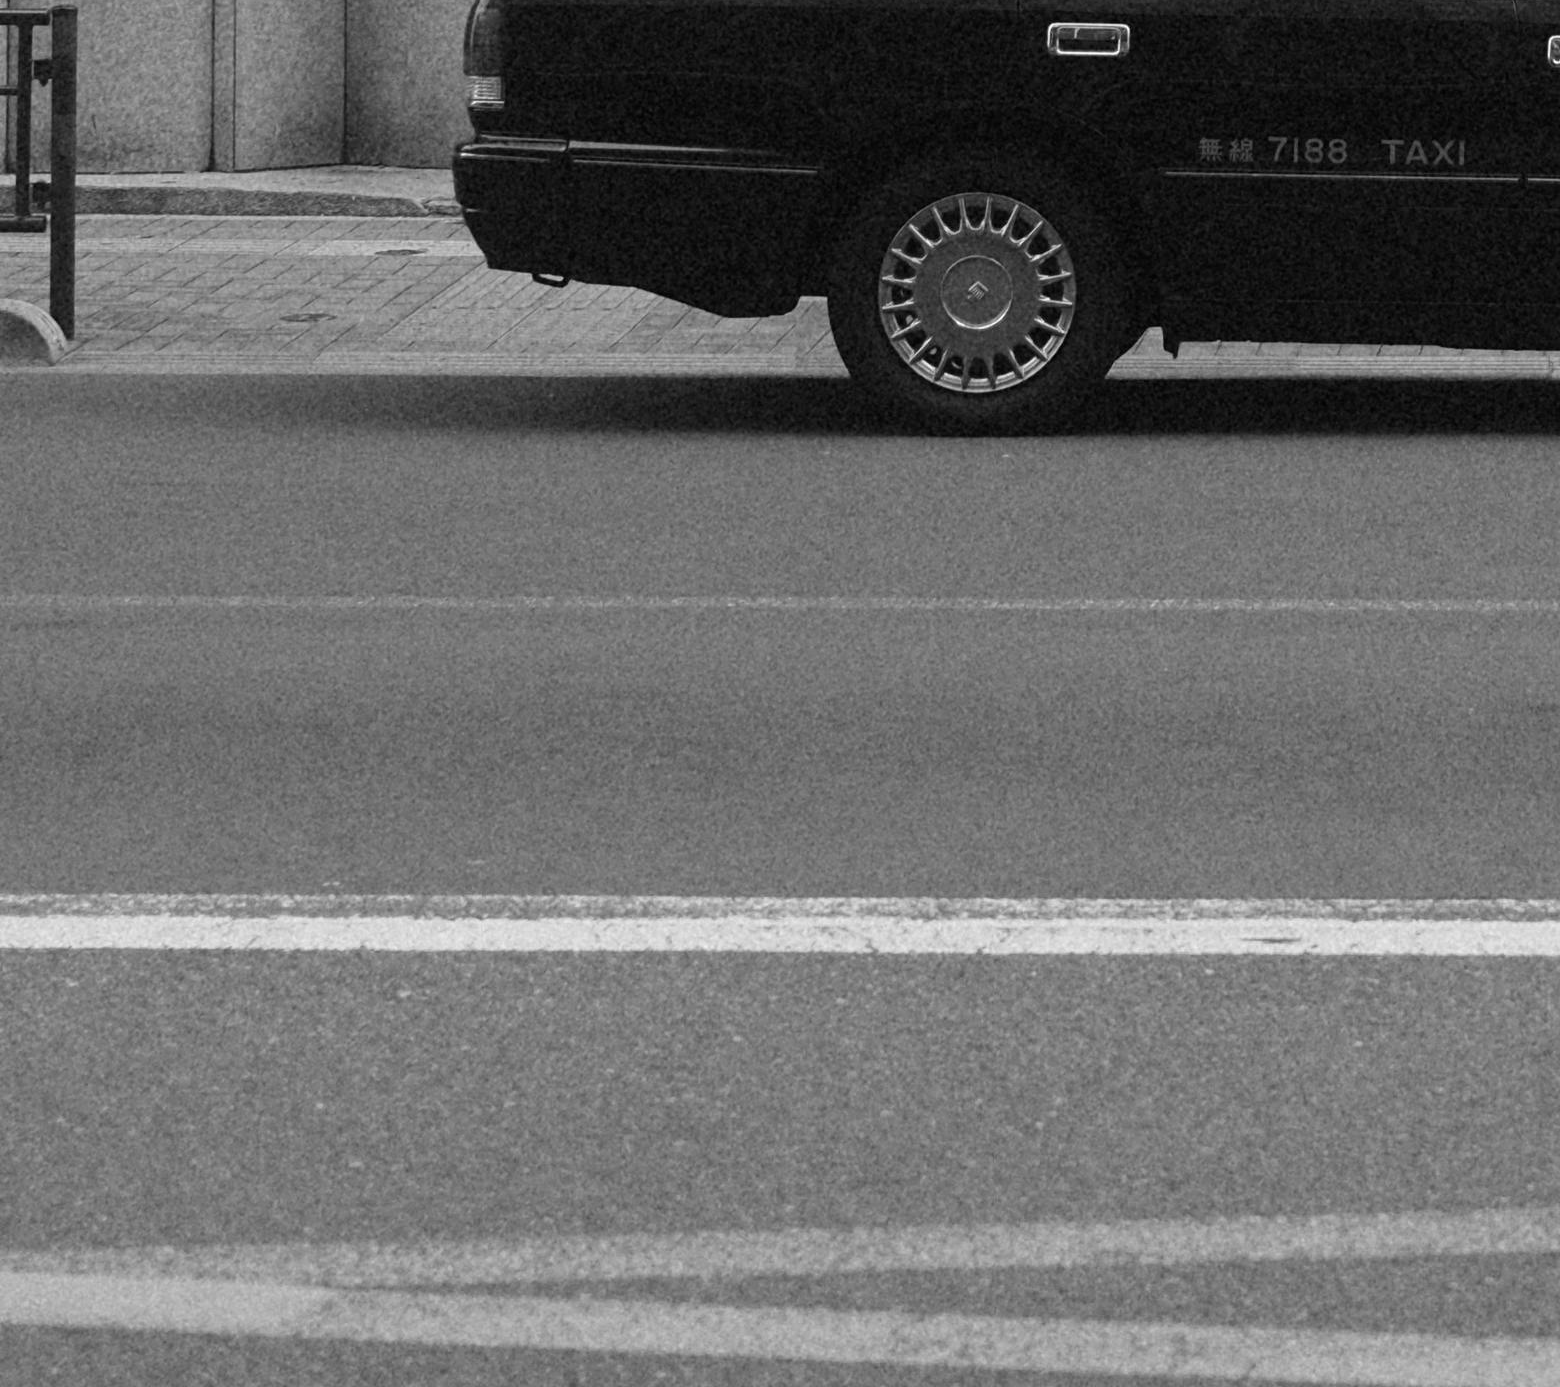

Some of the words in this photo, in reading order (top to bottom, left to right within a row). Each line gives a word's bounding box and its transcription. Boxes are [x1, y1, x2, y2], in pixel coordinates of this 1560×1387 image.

[1199, 137, 1254, 163] 無線
[1267, 135, 1348, 164] 7188
[1381, 139, 1466, 166] TAXI
